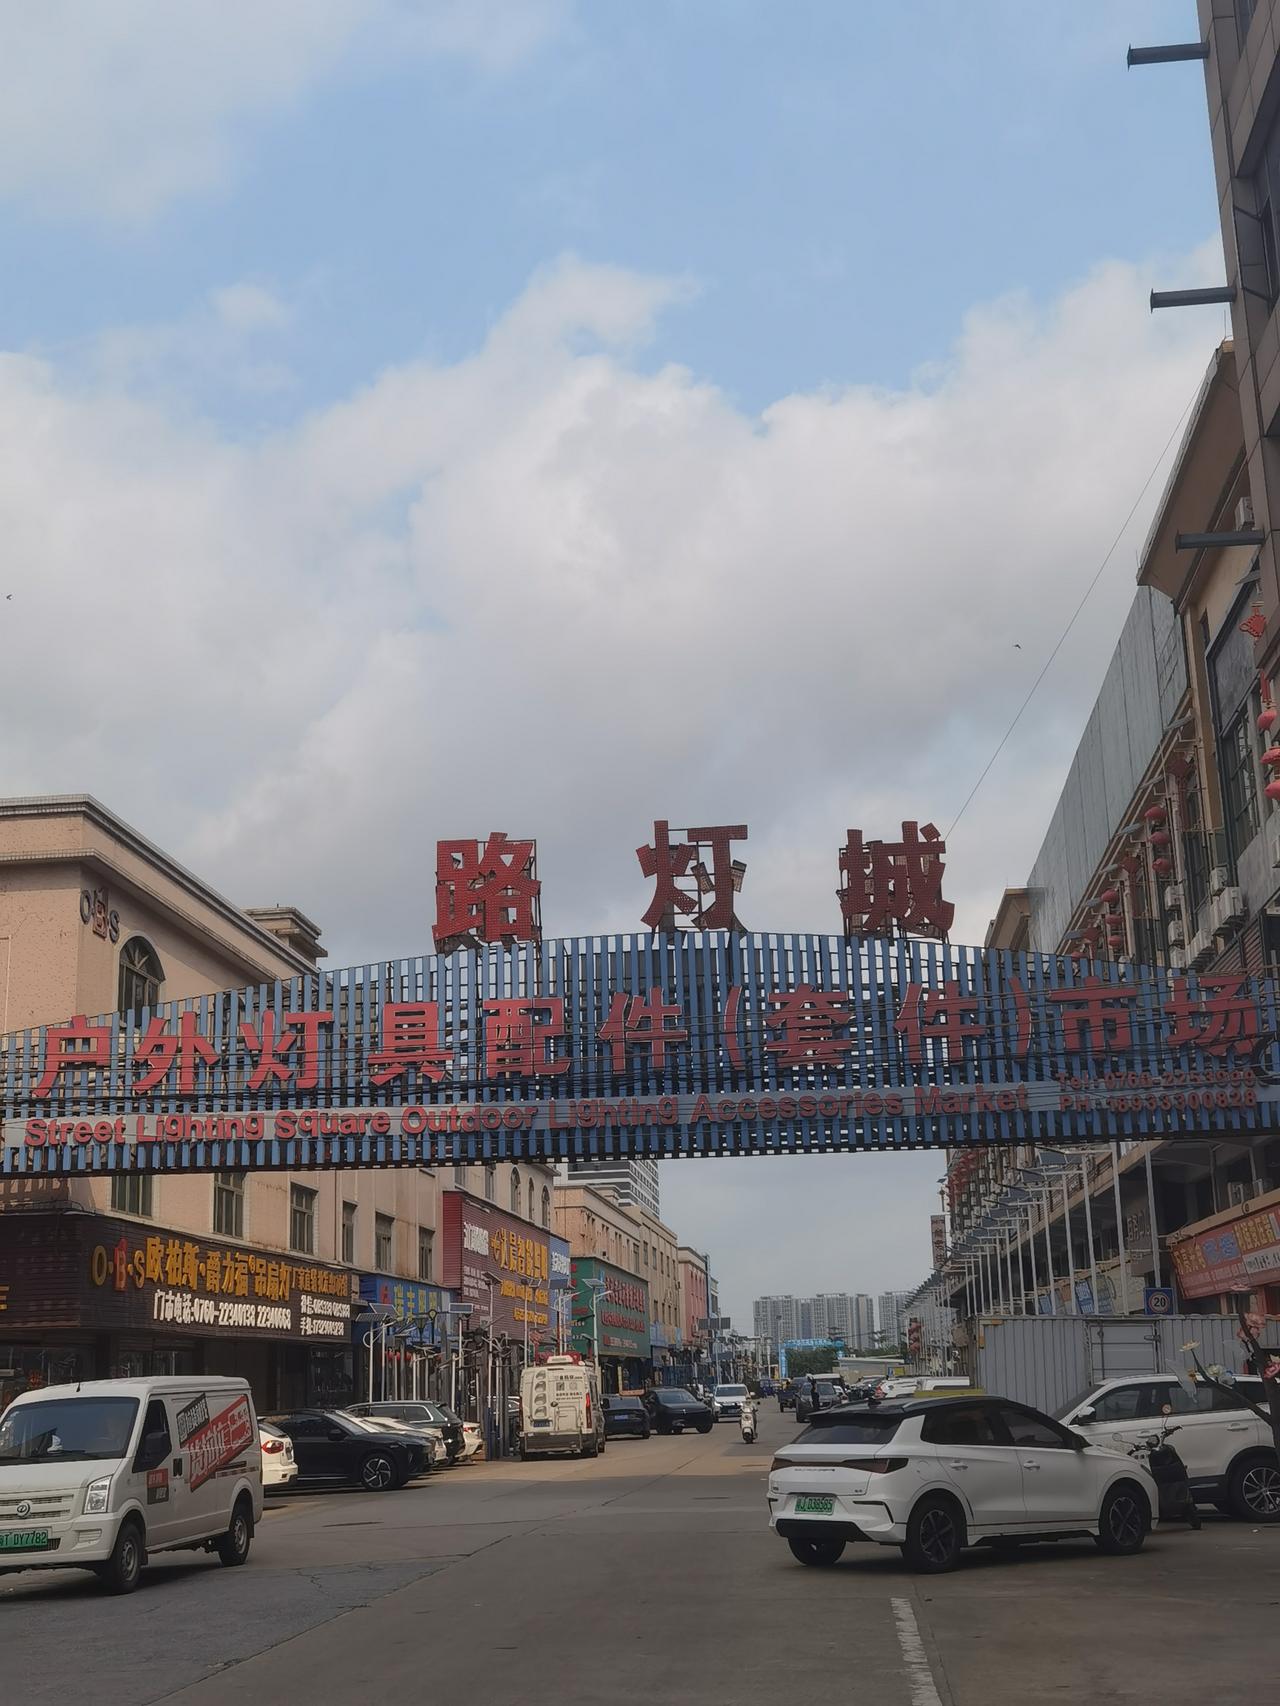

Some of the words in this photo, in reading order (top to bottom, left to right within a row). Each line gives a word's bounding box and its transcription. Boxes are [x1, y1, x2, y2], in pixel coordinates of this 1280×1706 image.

[24, 1117, 126, 1147] Street
[136, 1112, 265, 1144] Lighting
[275, 1109, 390, 1140] Square
[401, 1104, 539, 1135] Outdoor
[549, 1098, 679, 1131] Lighting
[691, 1090, 904, 1123] Accessories
[914, 1084, 1029, 1116] Market
[1153, 1297, 1166, 1308] 20
[13, 1530, 47, 1546] DY7782
